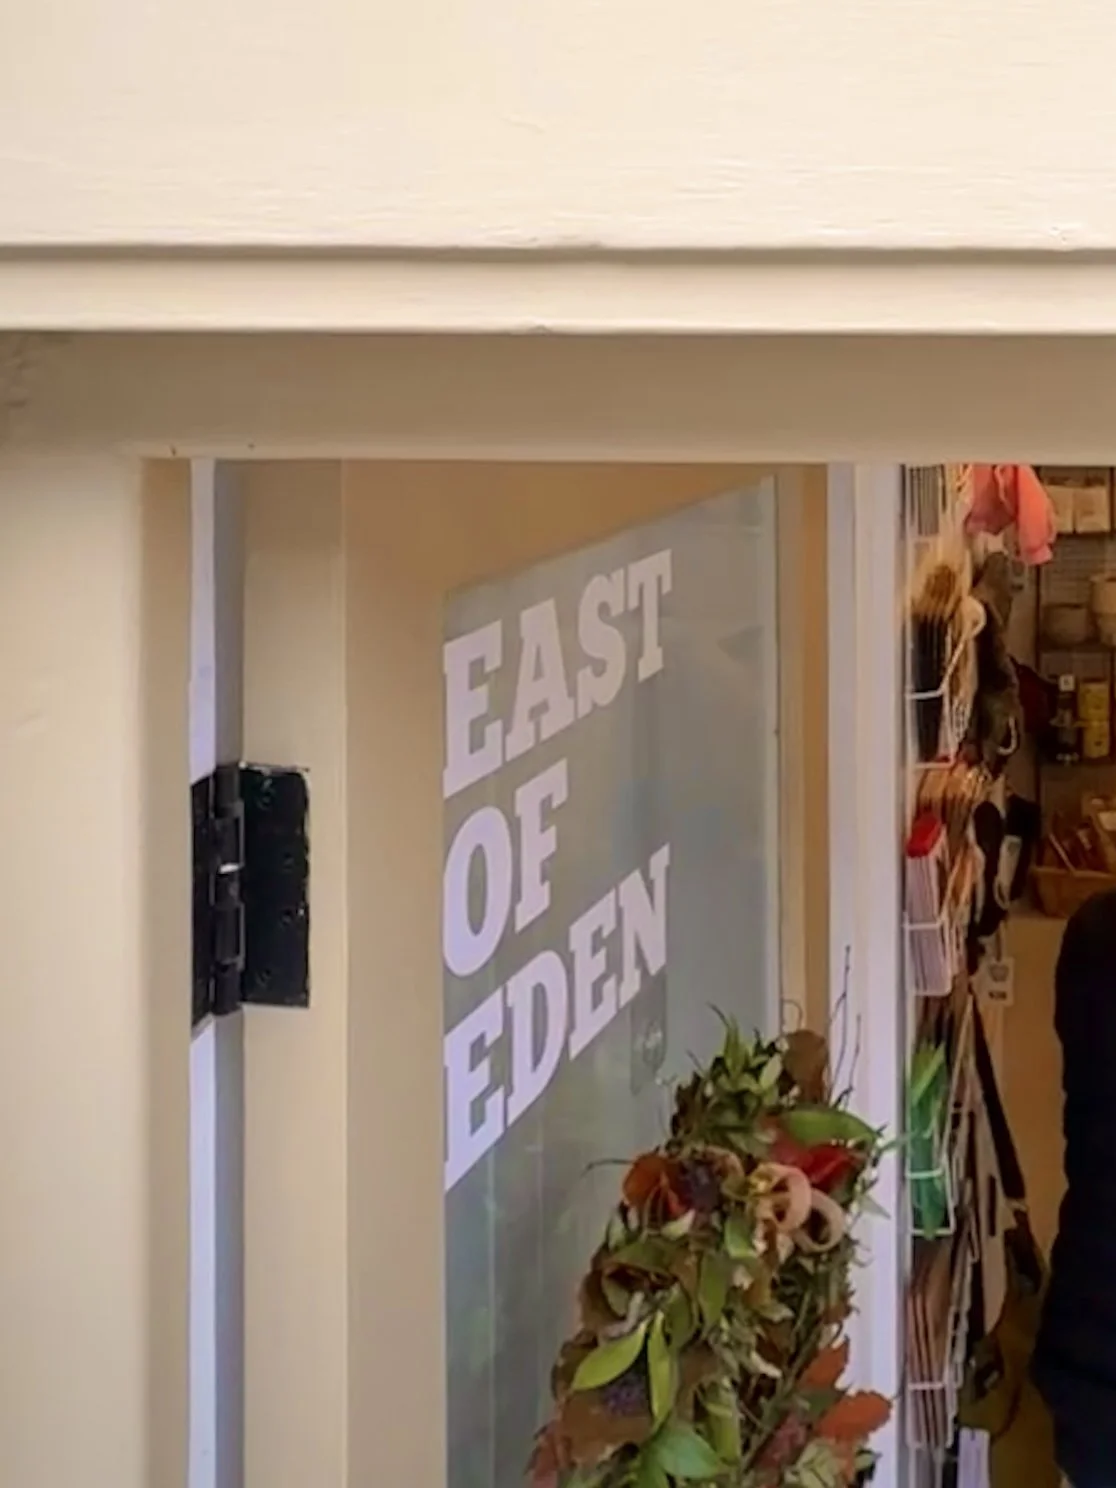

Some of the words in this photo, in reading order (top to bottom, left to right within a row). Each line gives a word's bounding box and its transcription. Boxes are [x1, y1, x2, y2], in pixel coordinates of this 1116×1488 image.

[443, 549, 672, 800] EAST
[442, 758, 568, 977] OF
[443, 842, 670, 1193] EDEN
